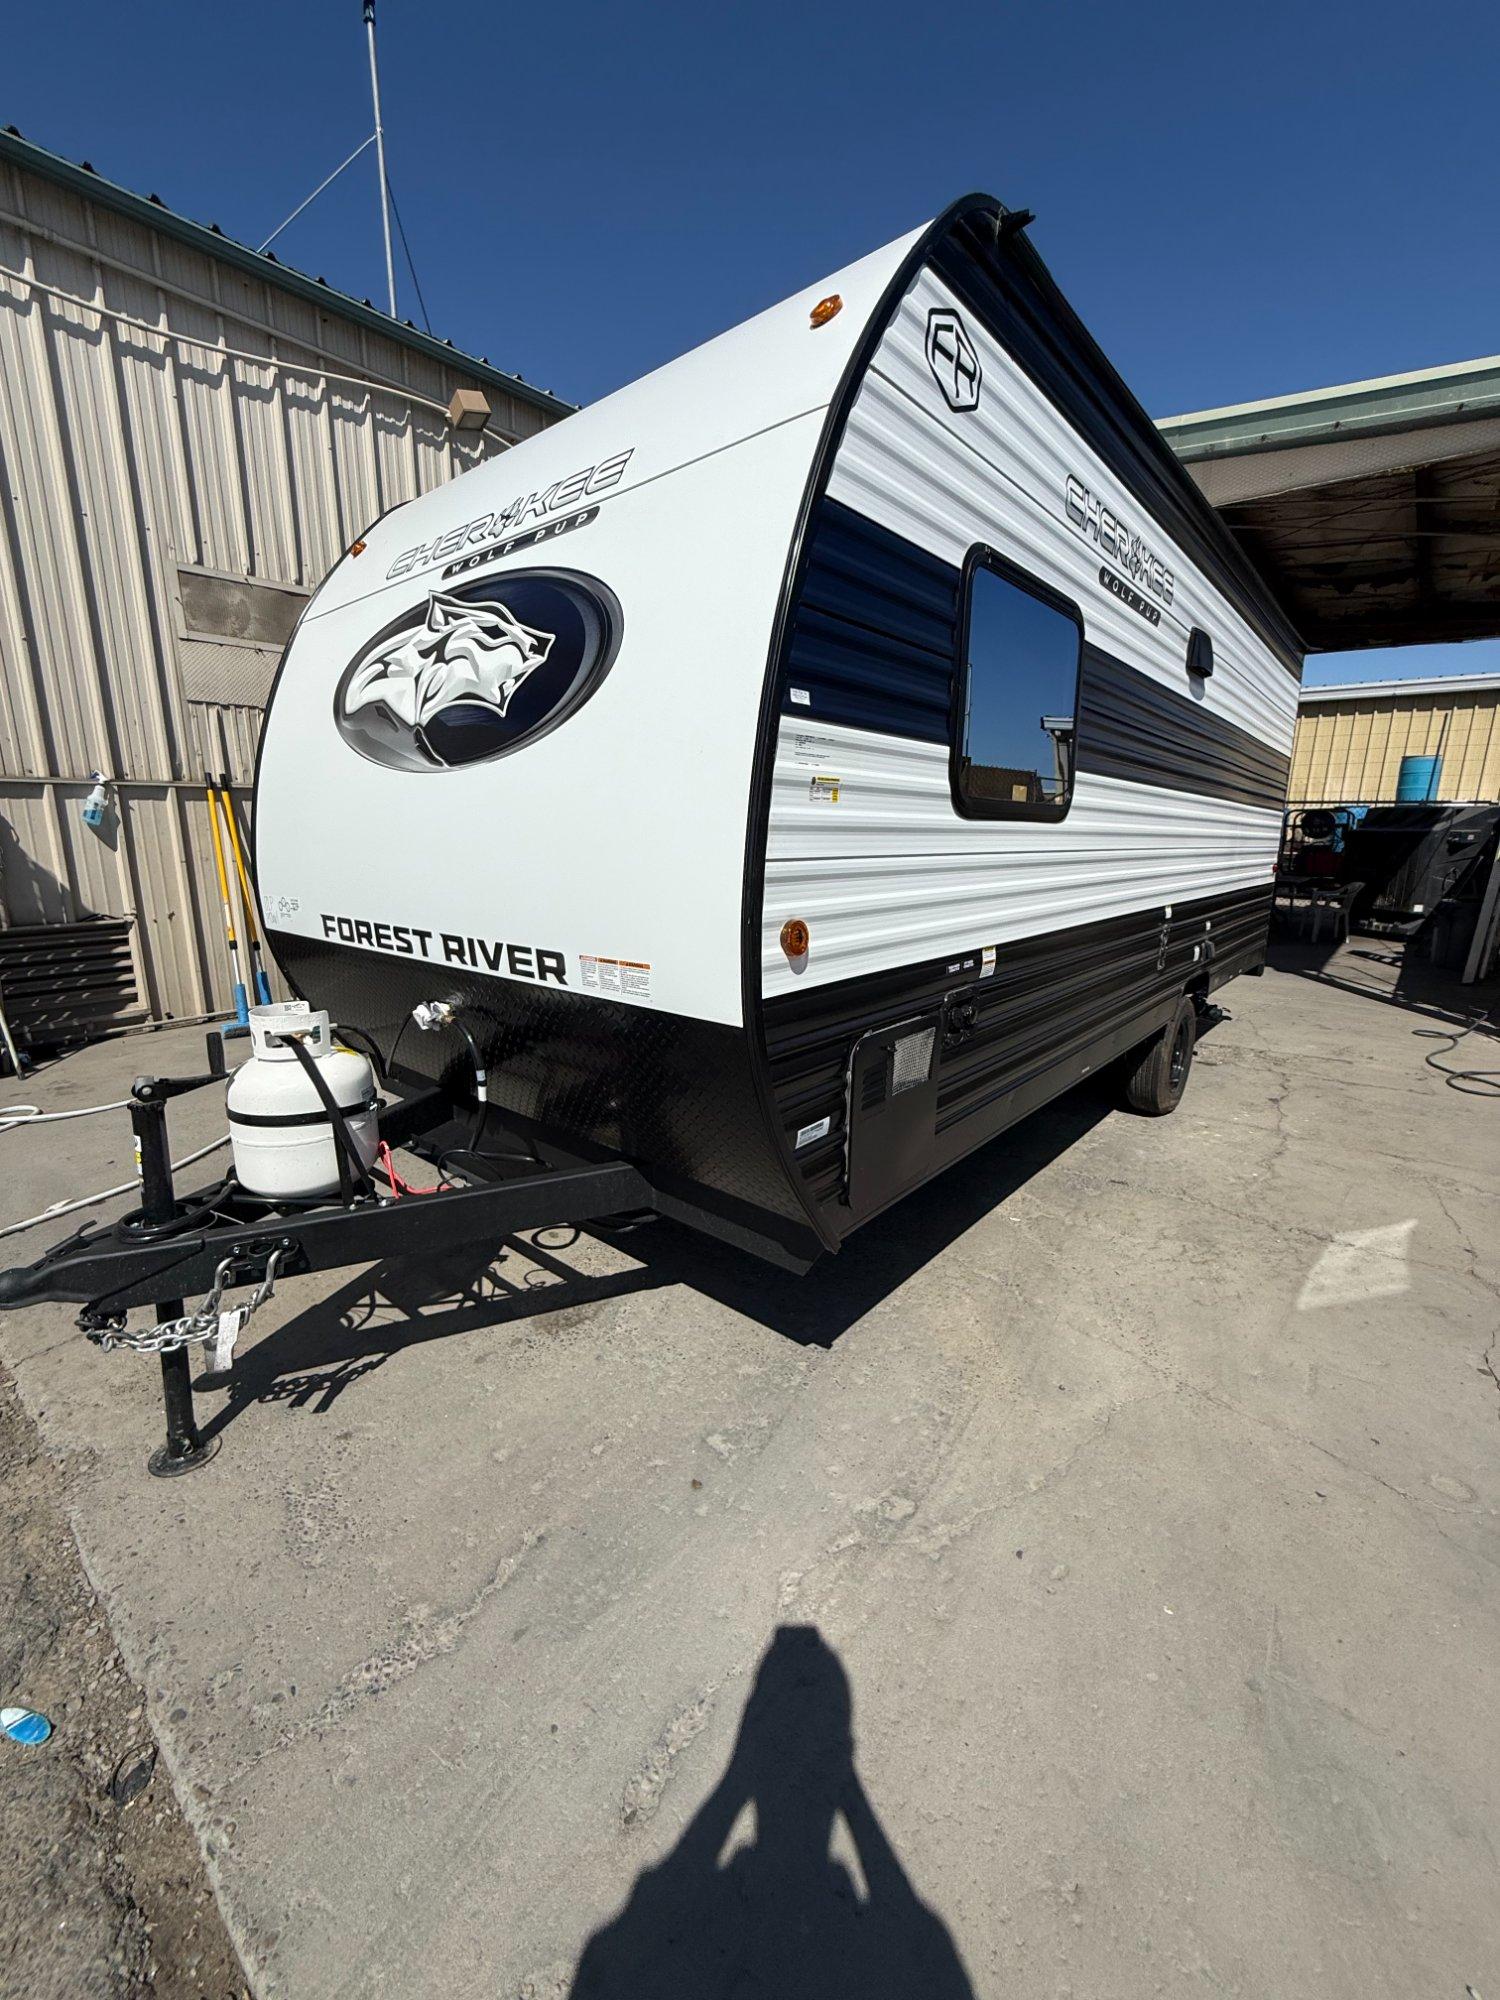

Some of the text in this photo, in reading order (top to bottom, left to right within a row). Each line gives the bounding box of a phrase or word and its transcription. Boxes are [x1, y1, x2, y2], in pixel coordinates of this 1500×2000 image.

[386, 447, 636, 580] CHEROKEE
[451, 512, 588, 574] WOLF PUP
[1065, 474, 1175, 606] CHEROKEE
[1103, 570, 1159, 621] WOLF PUP
[320, 913, 433, 957] FOREST
[439, 932, 569, 985] RIVER
